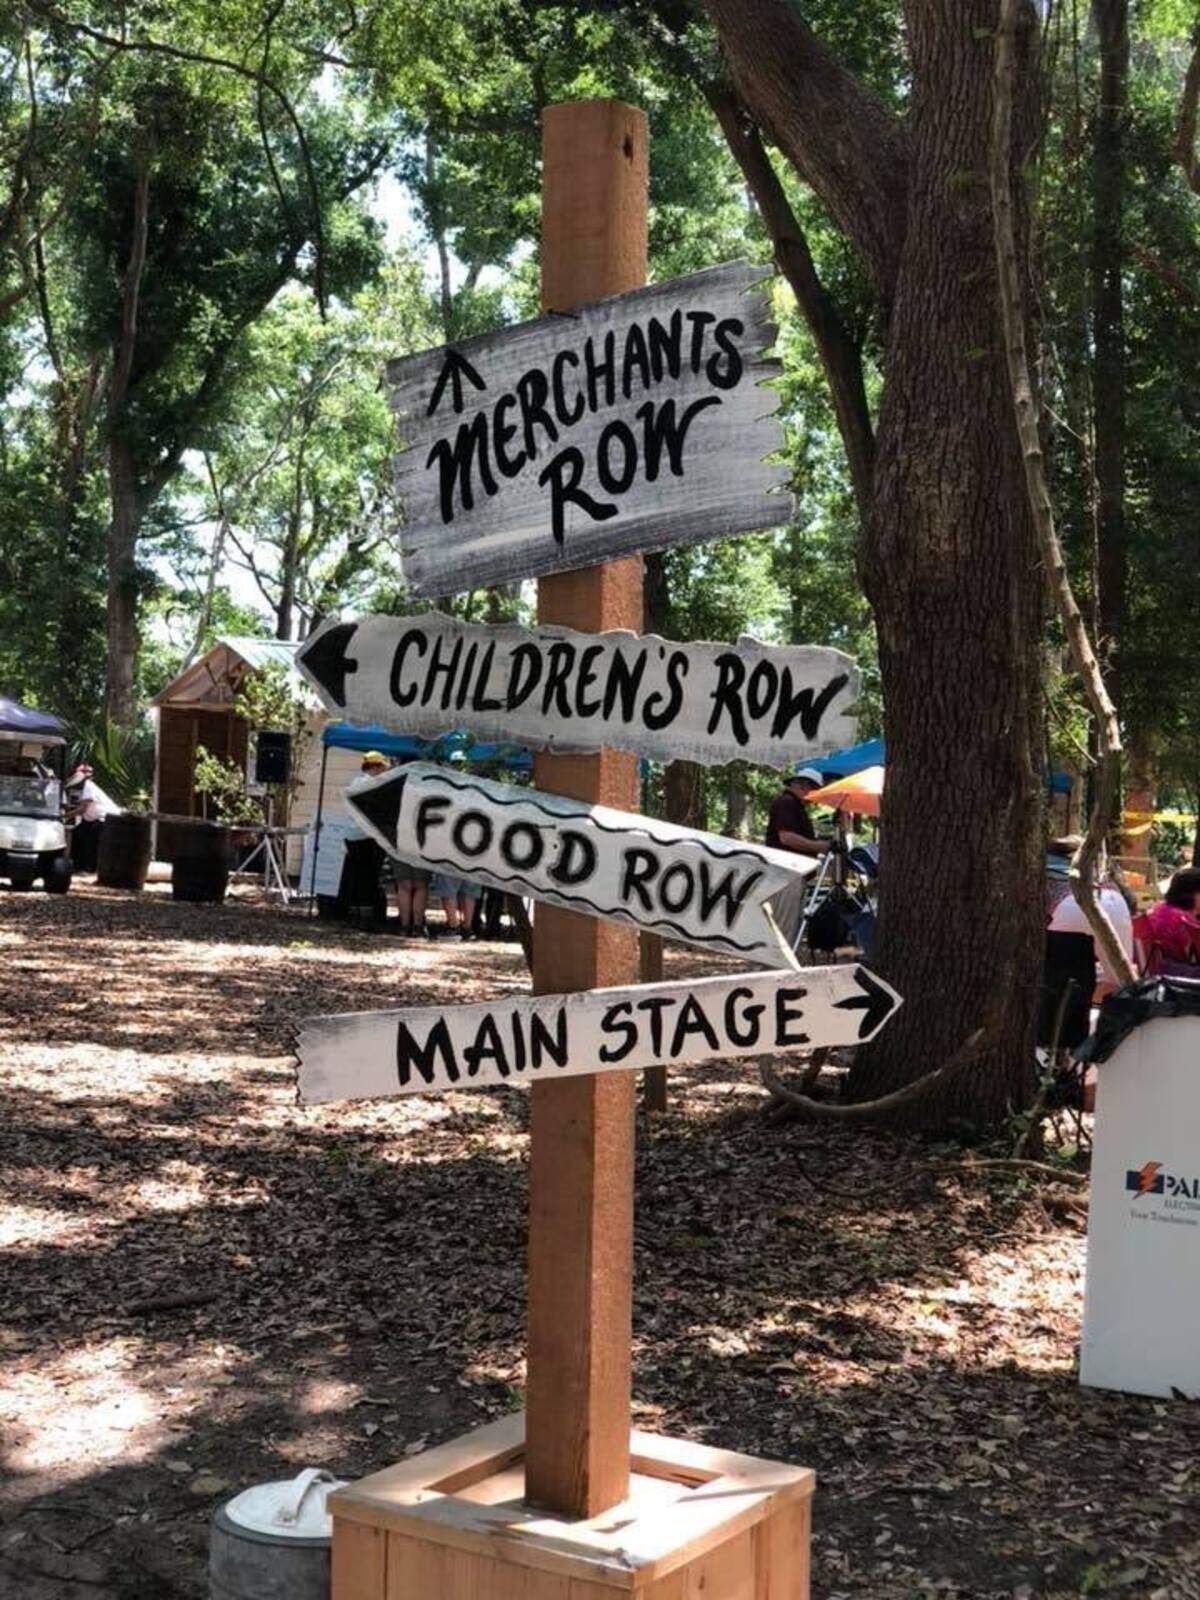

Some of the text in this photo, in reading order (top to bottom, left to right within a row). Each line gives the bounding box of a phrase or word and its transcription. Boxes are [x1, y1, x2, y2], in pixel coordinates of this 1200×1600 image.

[426, 308, 744, 525] MERCHANTS
[538, 396, 723, 546] ROW
[389, 628, 851, 746] CHILDREN'S ROW
[415, 795, 598, 886] FOOD
[621, 847, 767, 930] ROW
[396, 986, 811, 1086] MAIN STAGE
